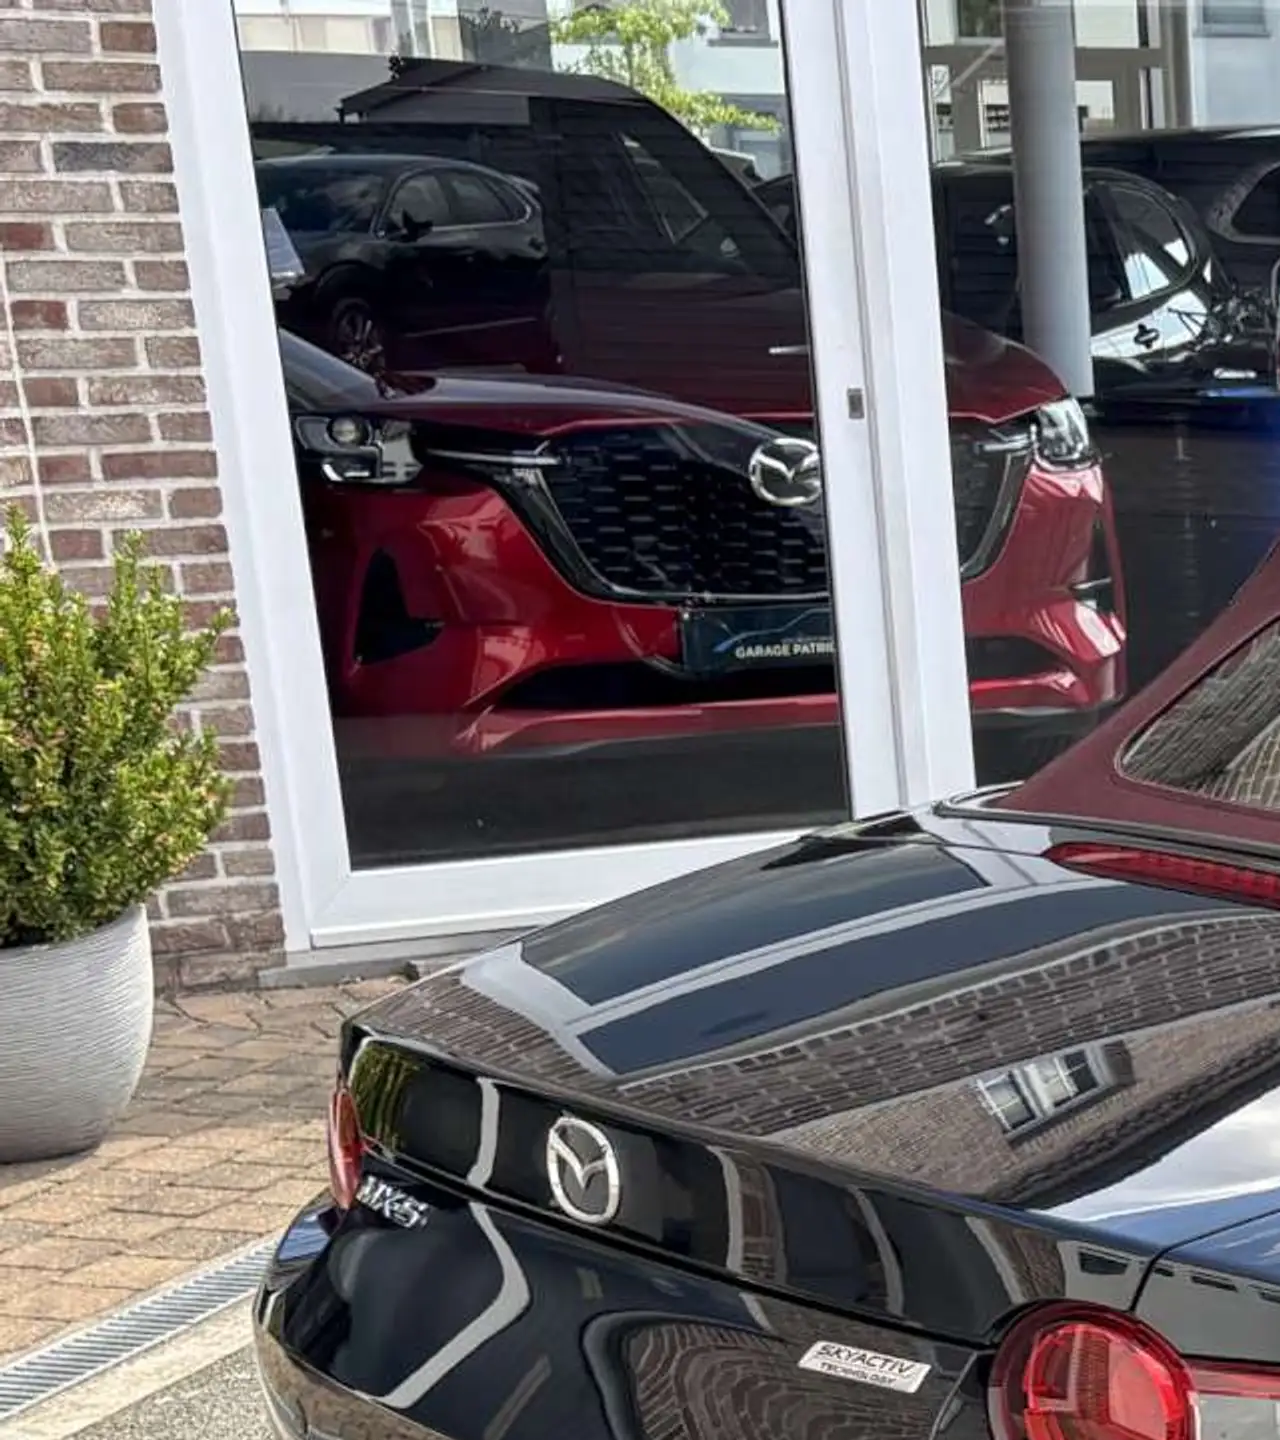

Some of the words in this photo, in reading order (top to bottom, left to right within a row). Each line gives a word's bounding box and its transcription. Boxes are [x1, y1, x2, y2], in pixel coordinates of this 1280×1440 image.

[735, 645, 791, 658] GARAGE
[817, 1343, 916, 1375] SKYACTIV
[819, 1361, 898, 1385] TECHNOLOGY
